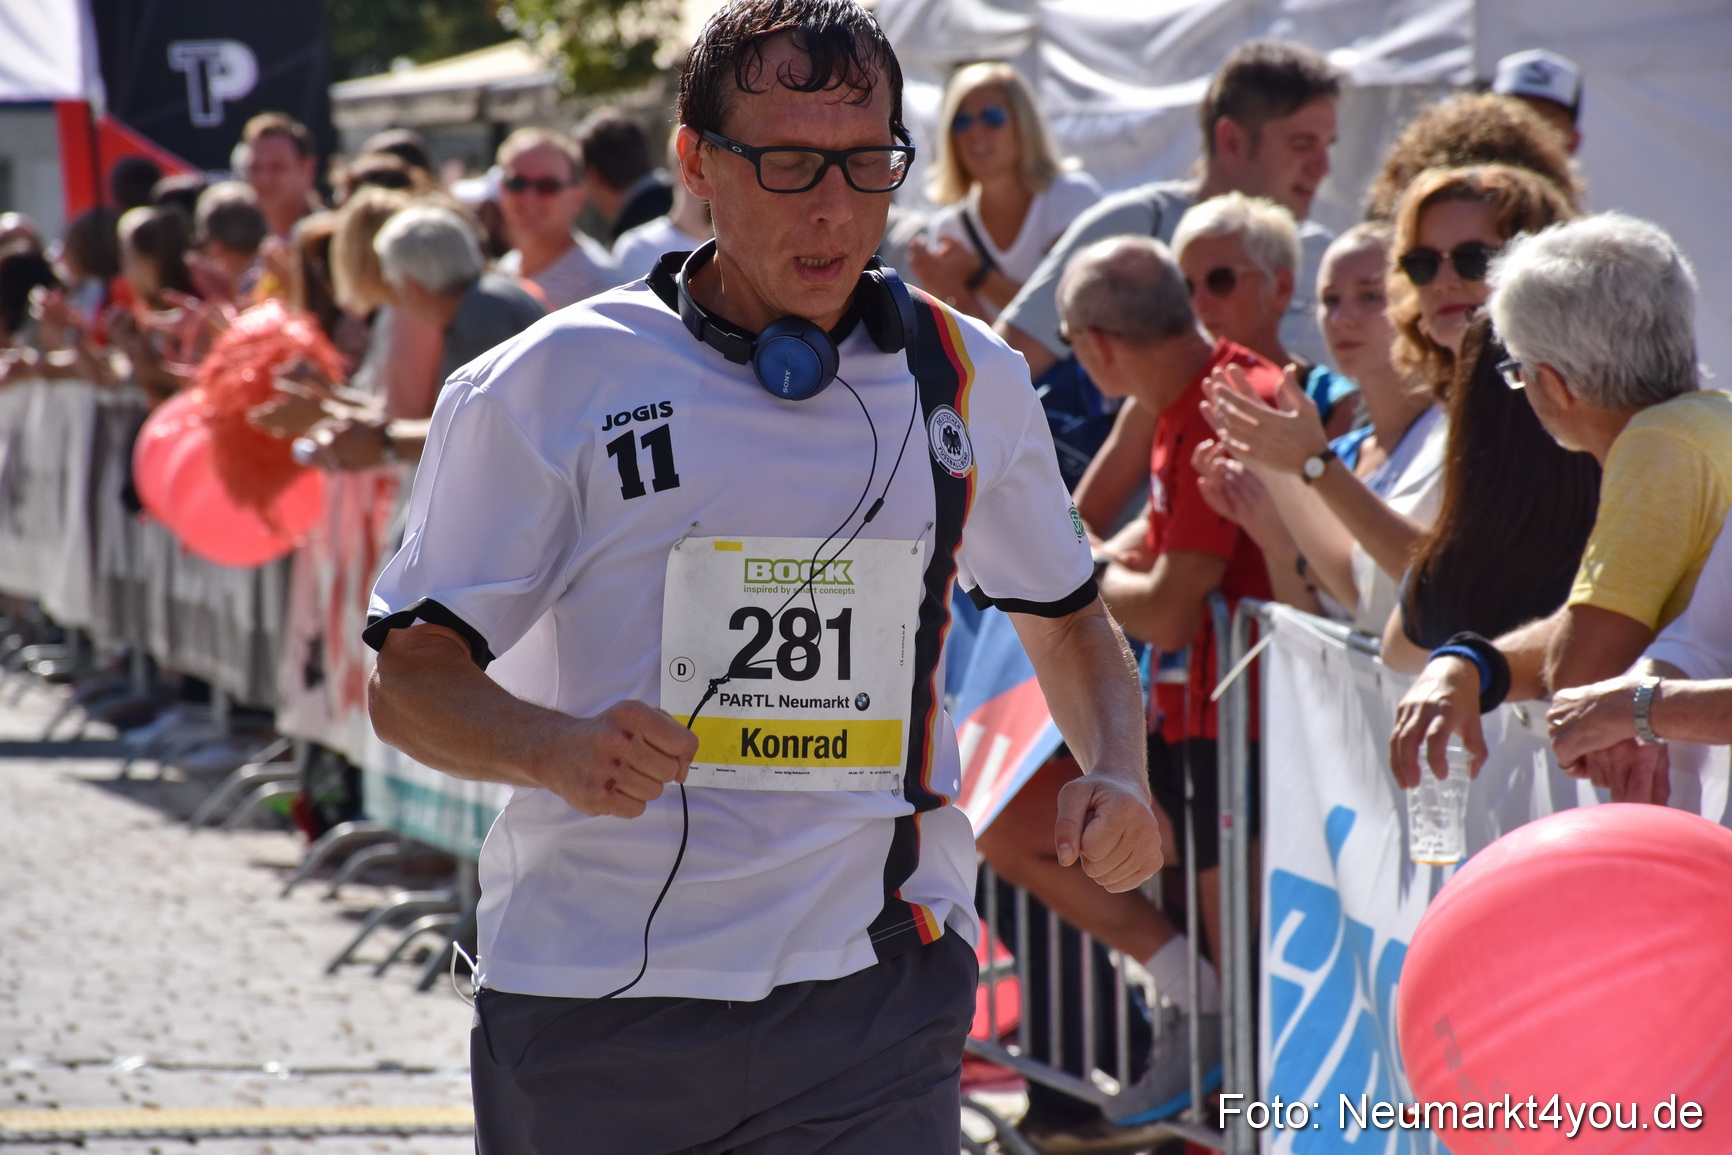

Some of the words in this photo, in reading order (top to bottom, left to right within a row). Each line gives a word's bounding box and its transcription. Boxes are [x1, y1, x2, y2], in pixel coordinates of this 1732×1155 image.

[782, 370, 791, 394] SONY
[601, 400, 674, 432] JOGIS
[605, 422, 681, 501] 11
[744, 558, 855, 585] BOCK
[743, 585, 779, 595] inspired
[780, 586, 791, 595] by
[819, 586, 856, 596] concepts
[728, 606, 853, 682] 281
[677, 663, 687, 676] D
[719, 692, 775, 708] PARTL
[778, 693, 850, 709] Neumarkt
[740, 727, 848, 760] Konrad
